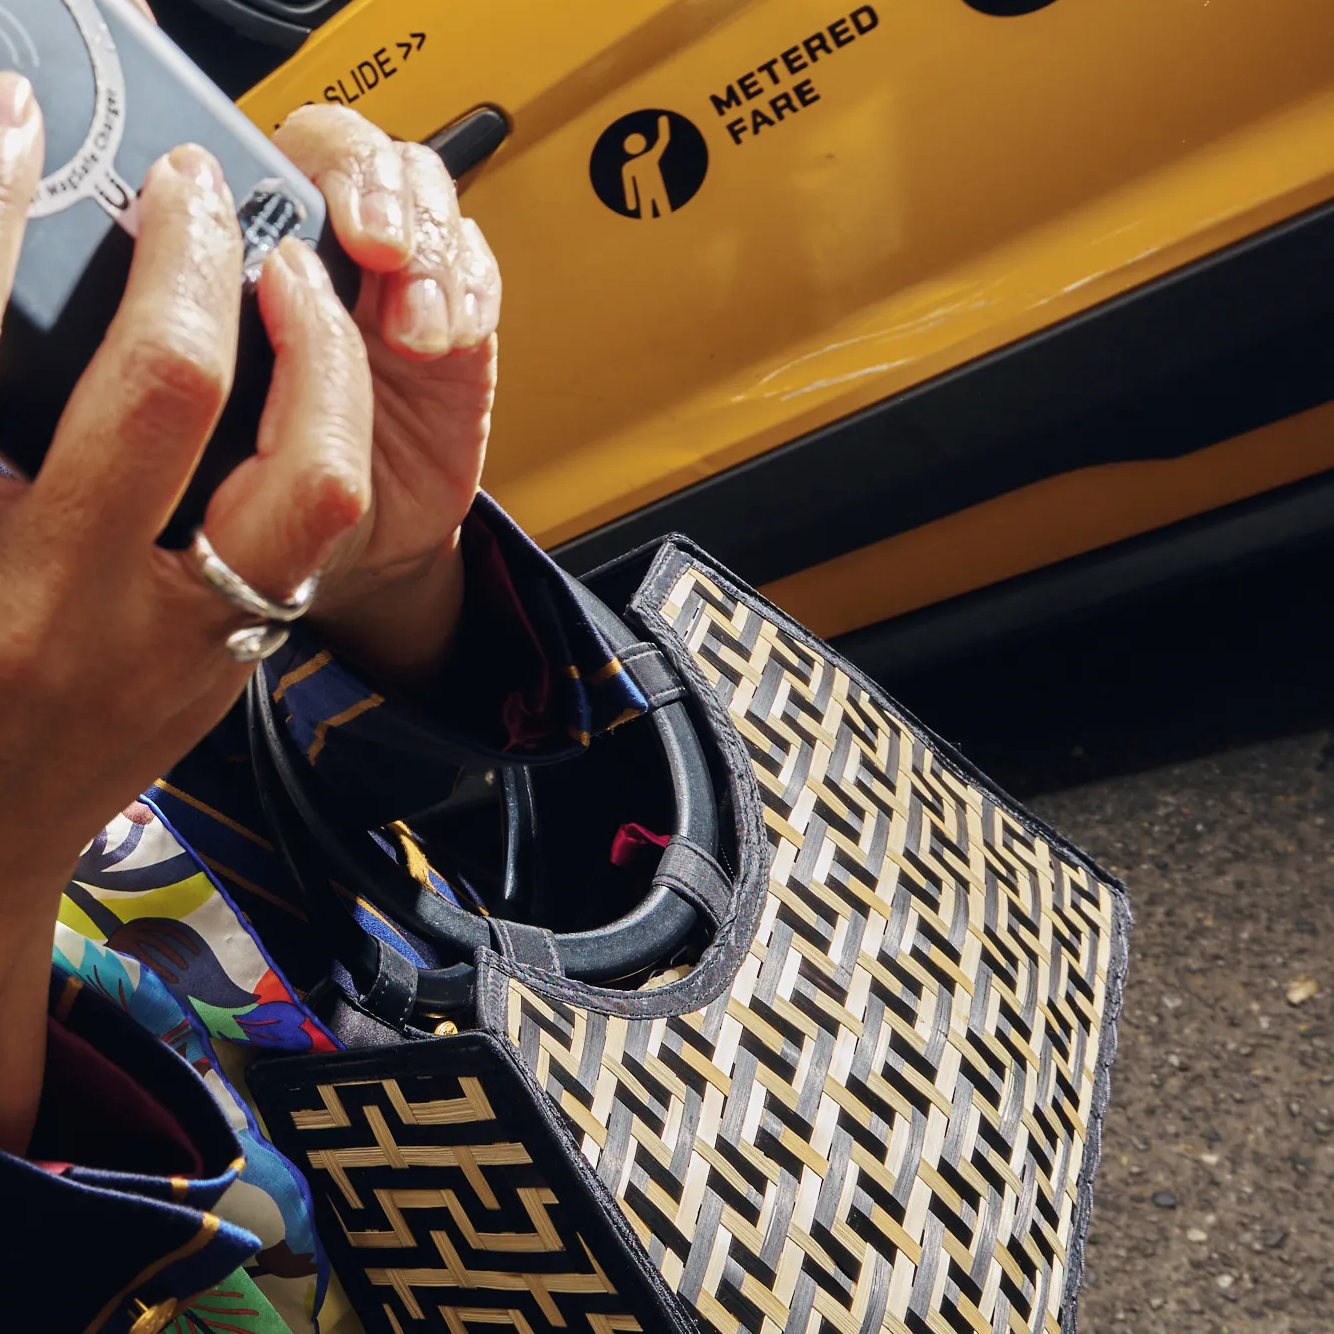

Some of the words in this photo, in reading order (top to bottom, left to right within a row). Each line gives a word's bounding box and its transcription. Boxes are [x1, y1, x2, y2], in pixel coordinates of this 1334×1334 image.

[322, 46, 399, 107] SLIDE
[708, 3, 880, 117] METERED
[725, 78, 822, 146] FARE
